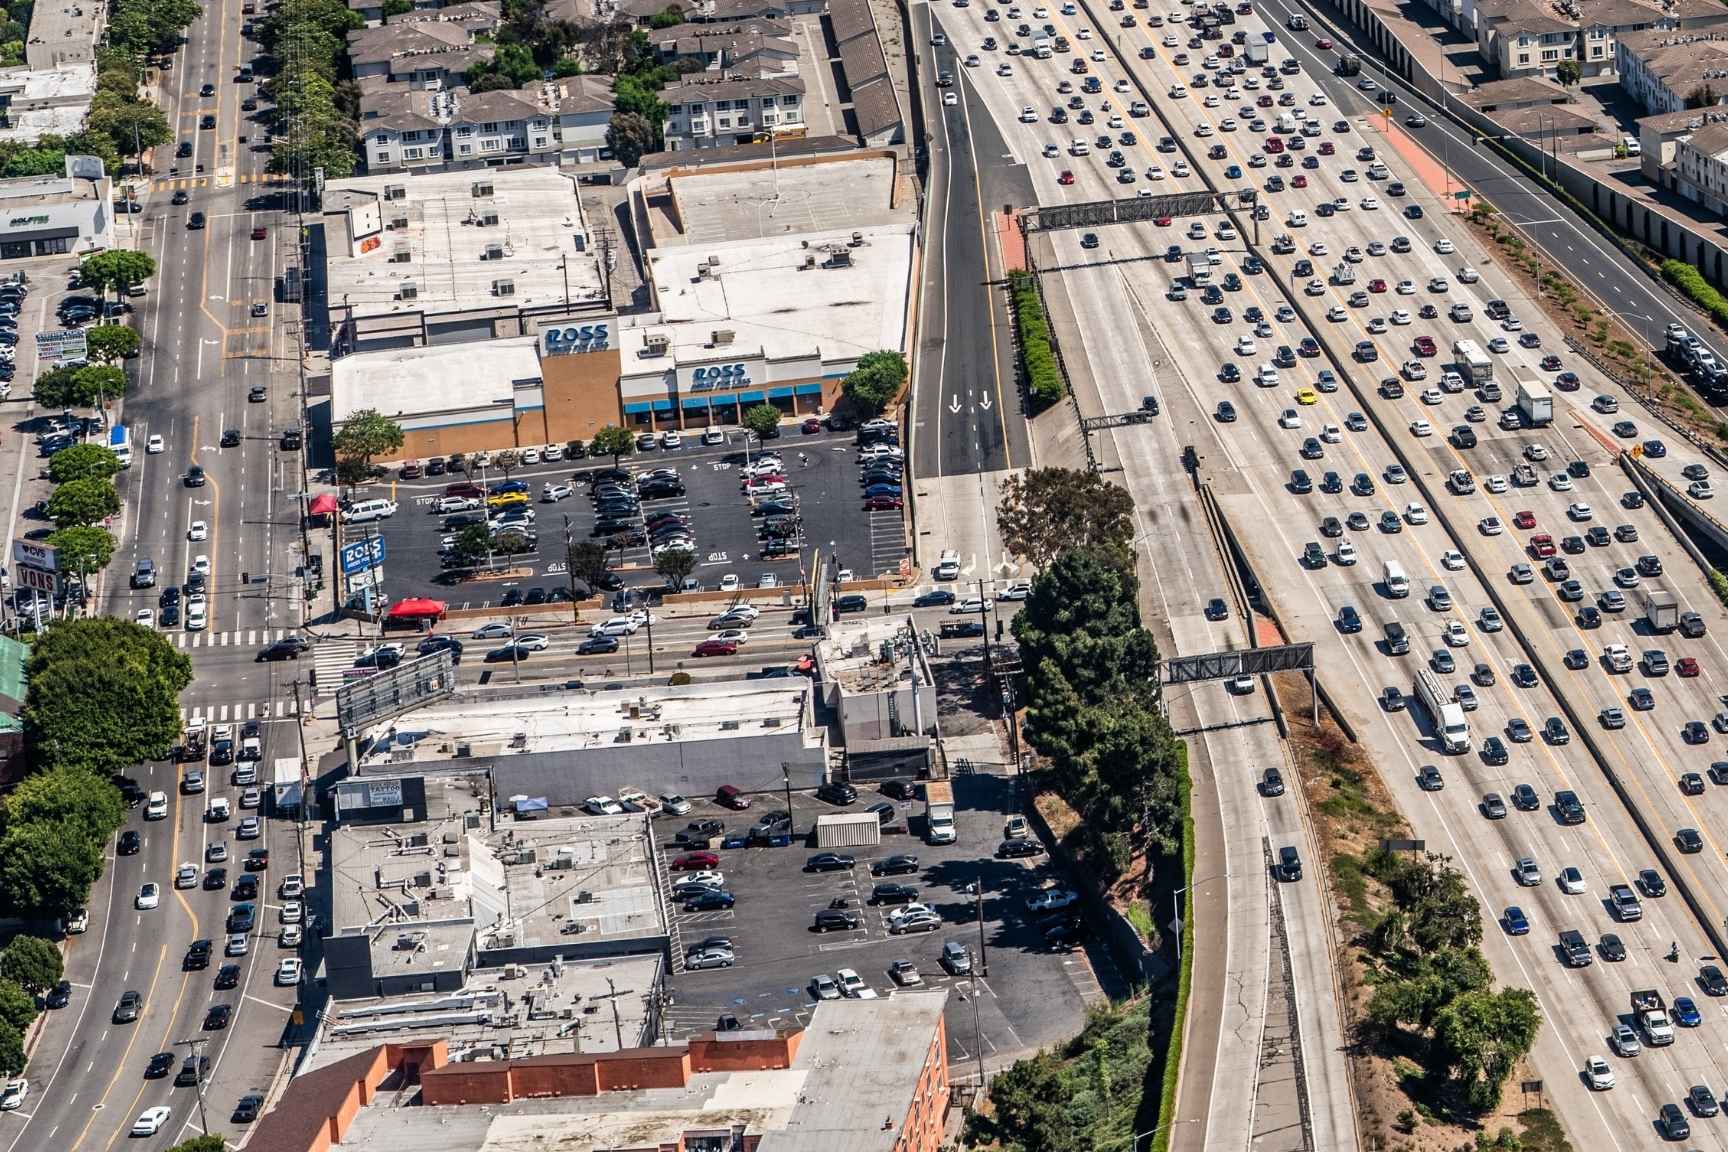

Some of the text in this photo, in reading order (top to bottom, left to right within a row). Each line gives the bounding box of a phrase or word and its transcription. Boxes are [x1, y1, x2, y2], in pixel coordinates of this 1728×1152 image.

[545, 324, 609, 344] ROSS
[694, 363, 745, 380] ROSS
[713, 463, 731, 471] STOP
[416, 498, 433, 506] STOP
[30, 546, 46, 558] CVS
[346, 539, 381, 563] ROSS
[708, 551, 728, 562] STOP
[547, 562, 566, 572] STOP
[21, 568, 53, 592] VONS
